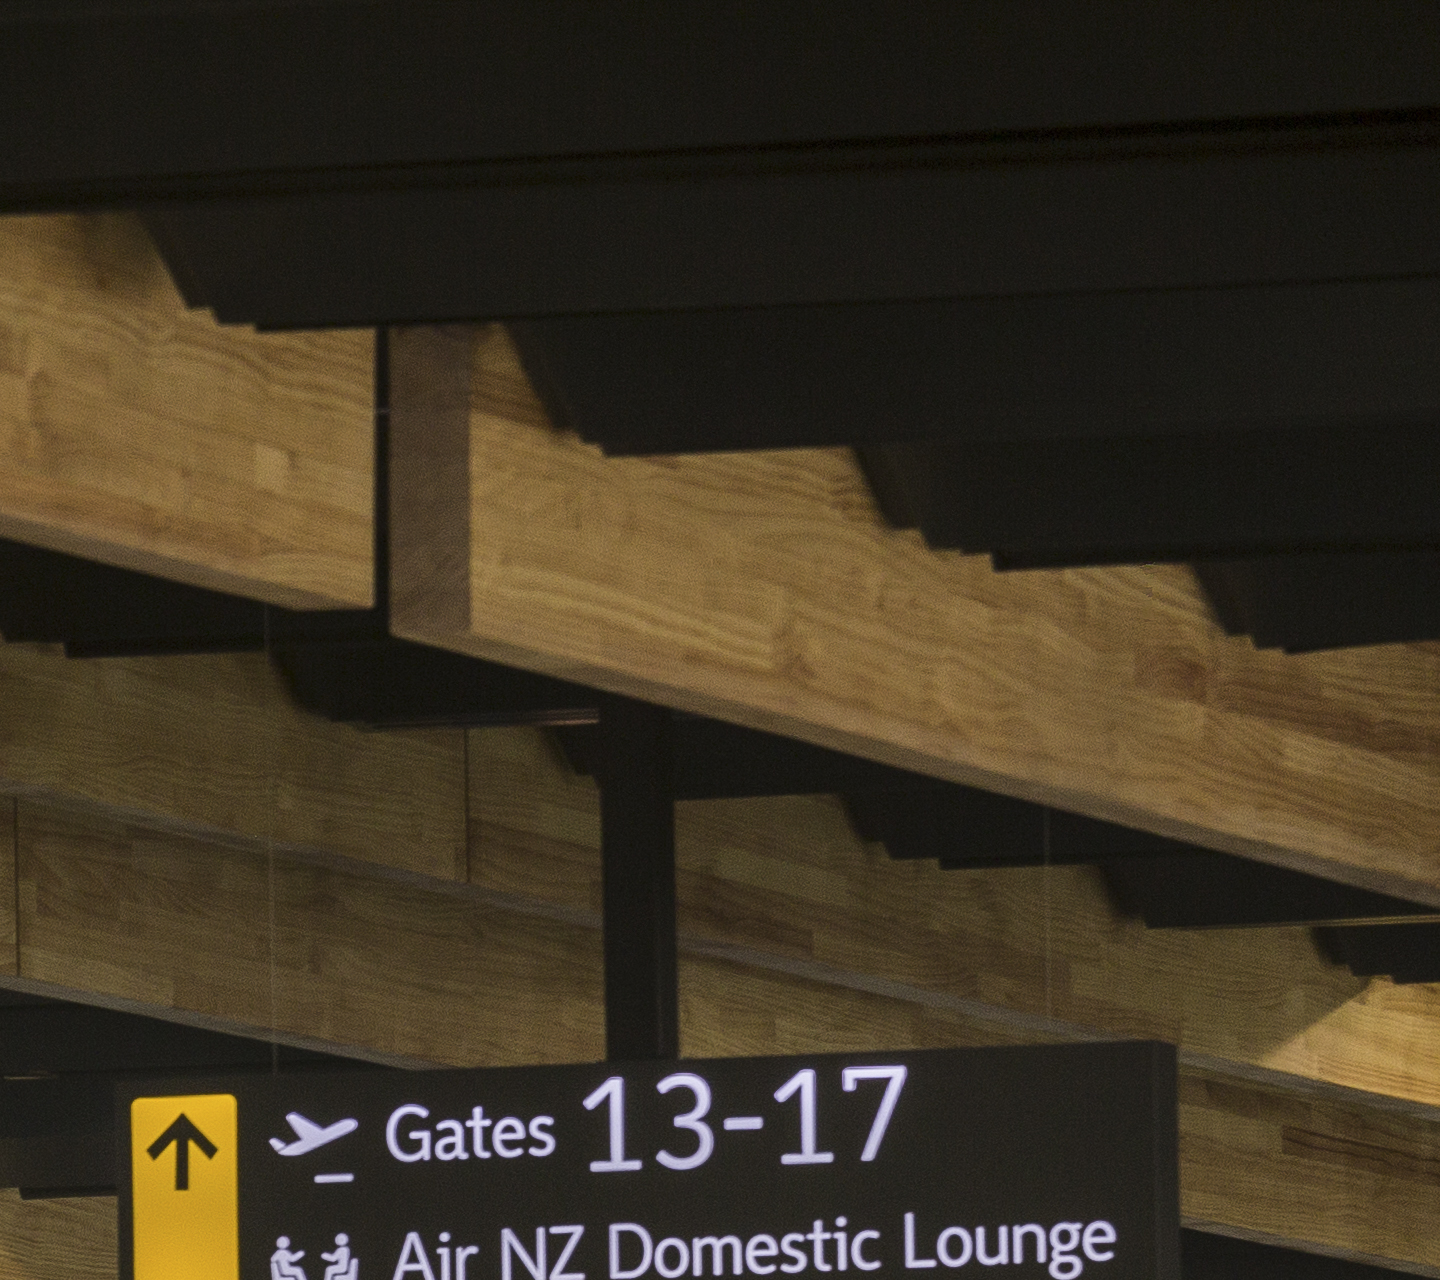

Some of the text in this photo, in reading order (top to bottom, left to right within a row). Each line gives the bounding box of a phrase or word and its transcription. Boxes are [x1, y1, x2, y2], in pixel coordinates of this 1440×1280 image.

[385, 1064, 908, 1173] Gates 13-17
[608, 1216, 882, 1280] Domestic
[904, 1212, 1117, 1280] Lounge
